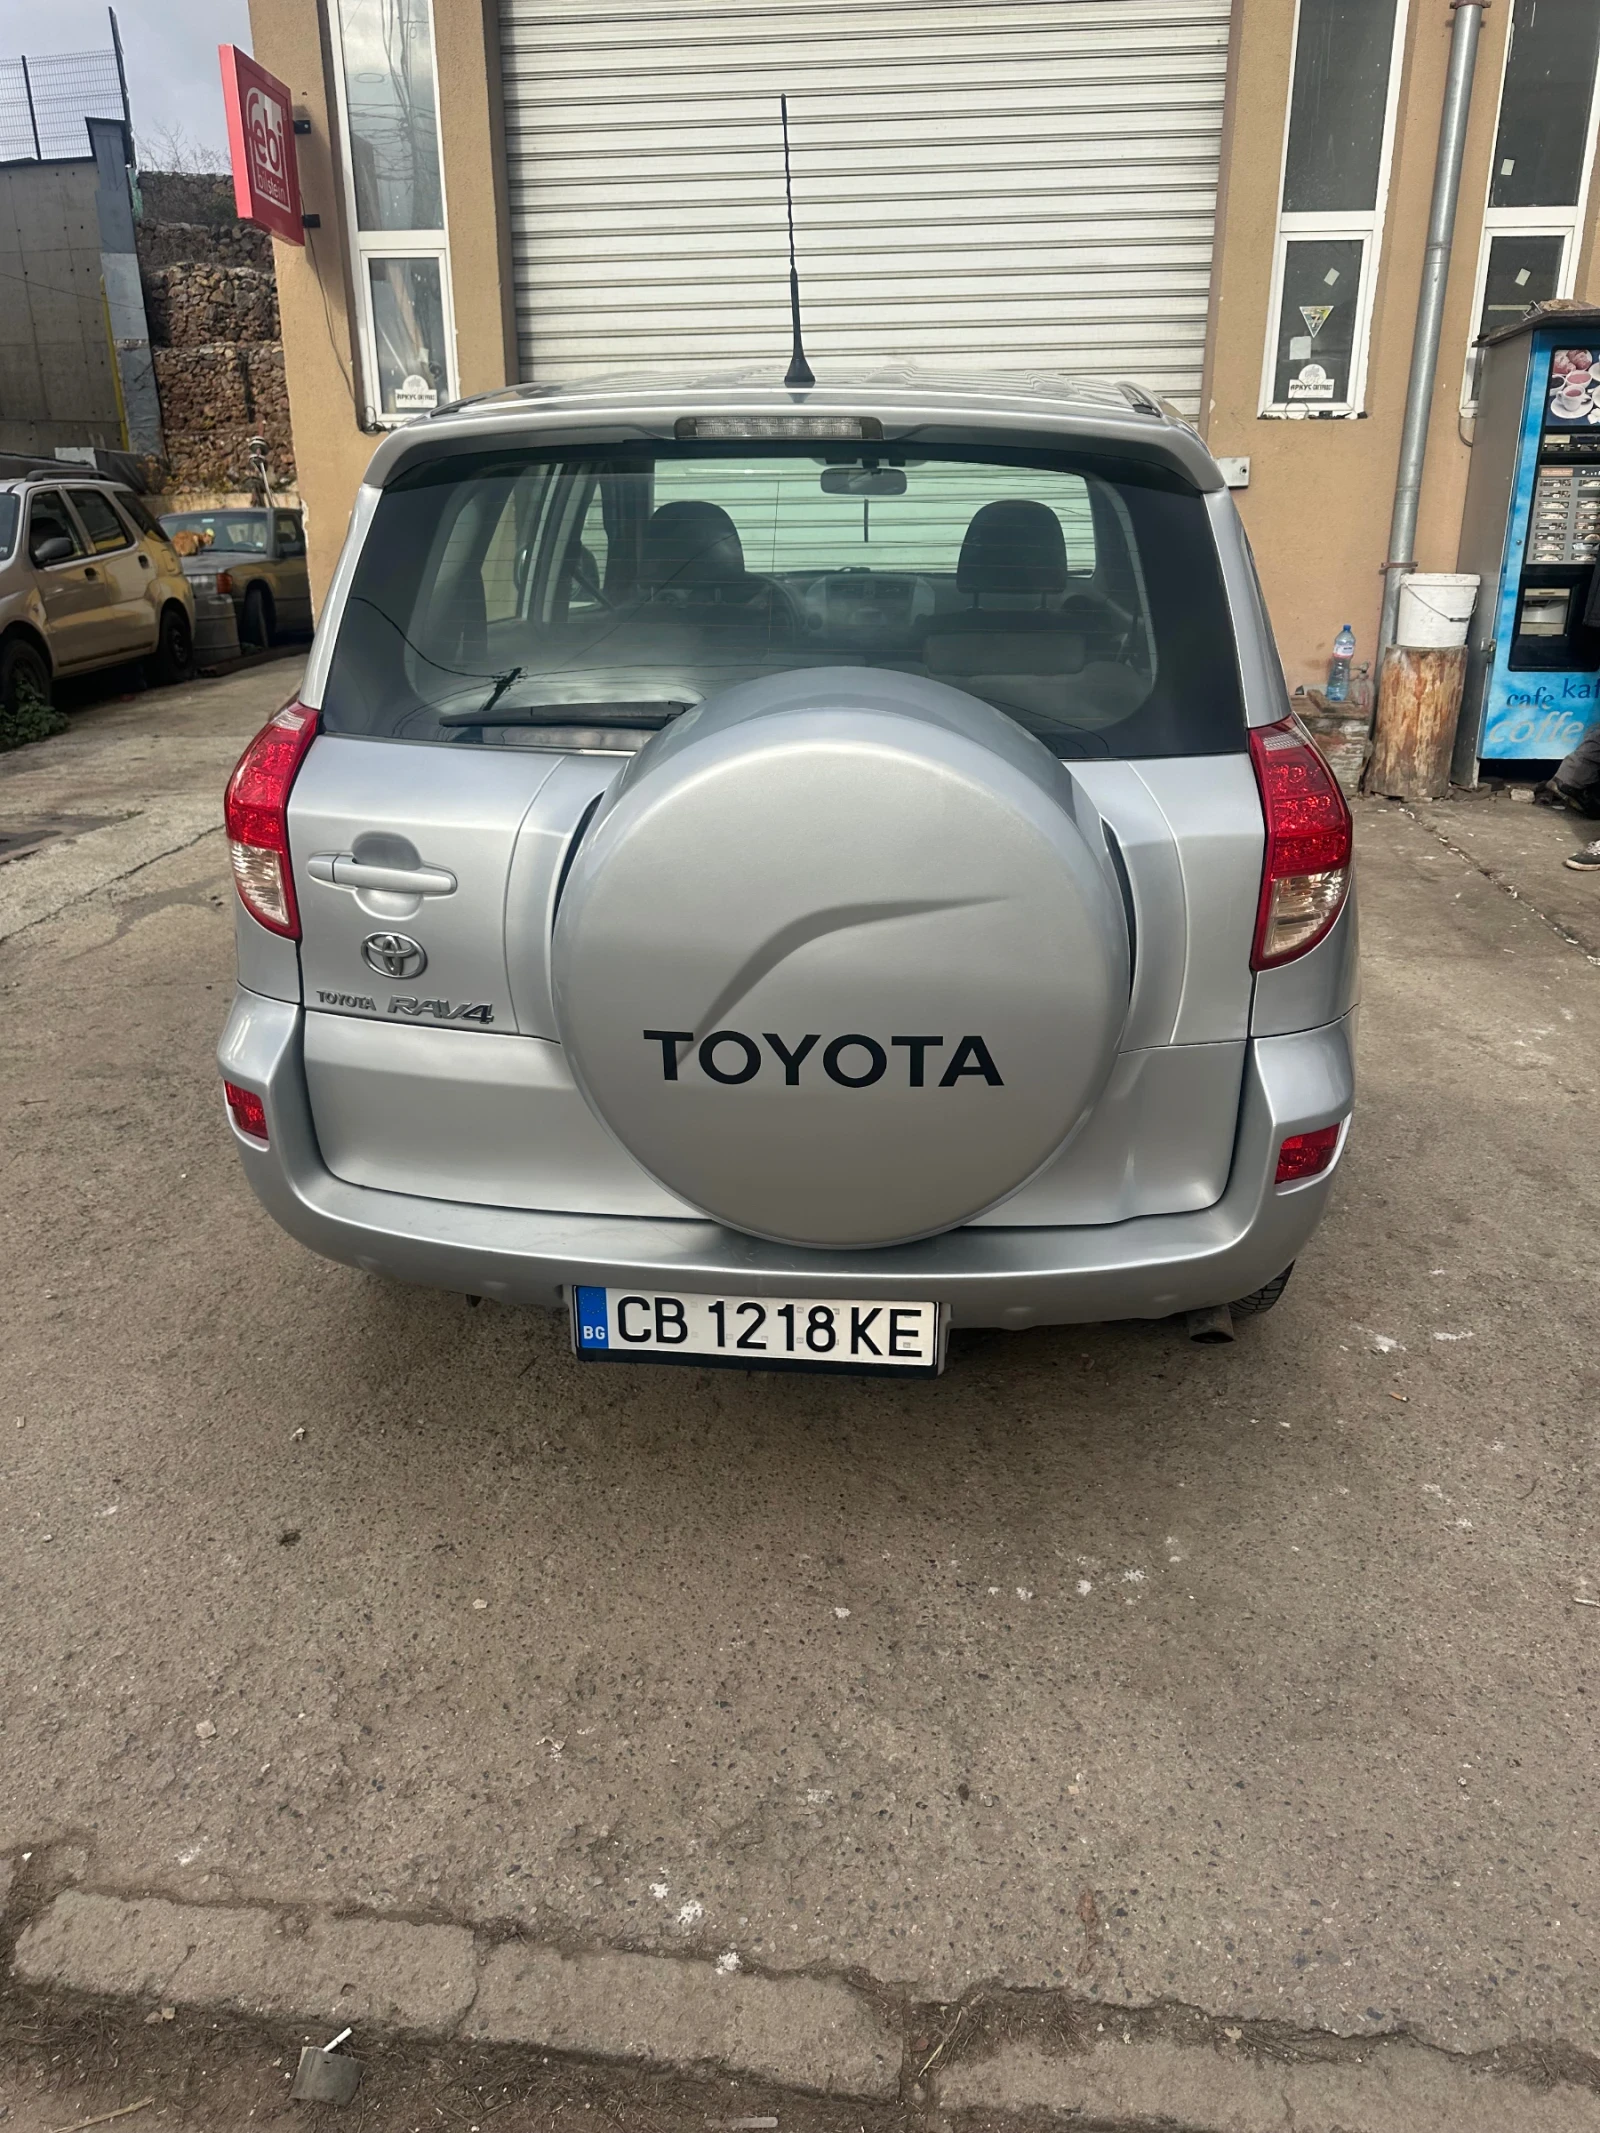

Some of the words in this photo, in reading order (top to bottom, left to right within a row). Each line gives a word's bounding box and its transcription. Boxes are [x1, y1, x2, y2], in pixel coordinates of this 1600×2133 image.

[246, 88, 284, 176] febi
[257, 166, 286, 204] bilstein
[1506, 686, 1555, 710] cafe
[1489, 710, 1585, 744] coffe
[316, 990, 377, 1011] TOYOTA
[387, 994, 495, 1024] RAV4
[643, 1029, 1006, 1088] TOYOTA
[583, 1325, 606, 1339] BG
[616, 1296, 688, 1344] CB
[708, 1299, 838, 1353] 1218
[850, 1307, 924, 1358] KE
